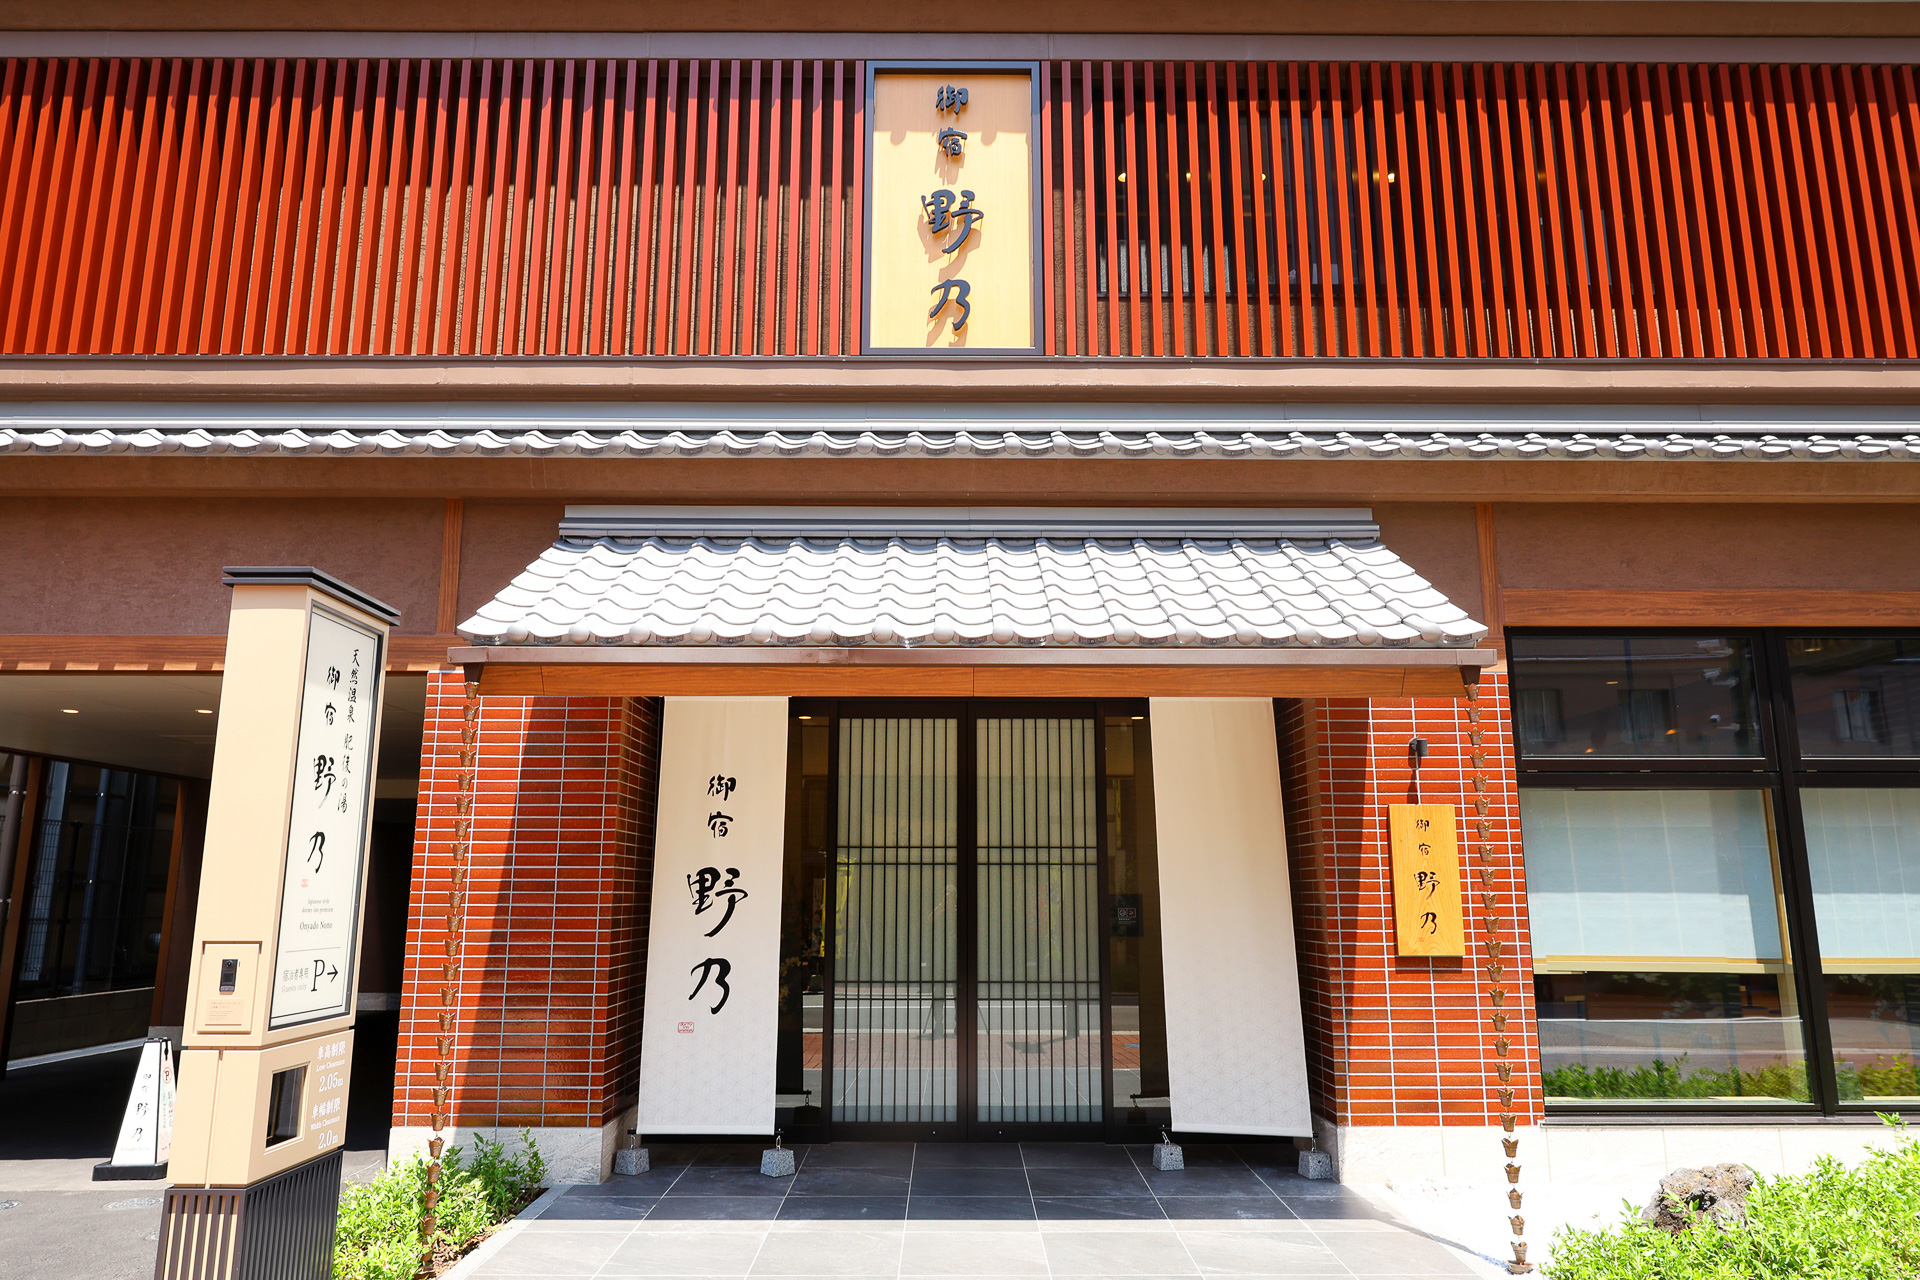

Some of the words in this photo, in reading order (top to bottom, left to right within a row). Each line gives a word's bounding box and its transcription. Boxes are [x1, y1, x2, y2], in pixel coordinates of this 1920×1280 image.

[921, 84, 984, 331] 御宿野乃
[307, 666, 340, 874] 御宿野乃
[1413, 818, 1440, 935] 御宿野乃
[686, 773, 749, 1015] 御宿野乃
[299, 921, 319, 933] Onyado
[320, 921, 333, 929] Nono
[311, 959, 325, 992] P
[317, 1041, 346, 1061] 車高制限
[316, 1063, 326, 1073] Low
[318, 1072, 344, 1093] 2.05m
[311, 1097, 341, 1120] 車幅制限
[317, 1129, 339, 1150] 2.0m
